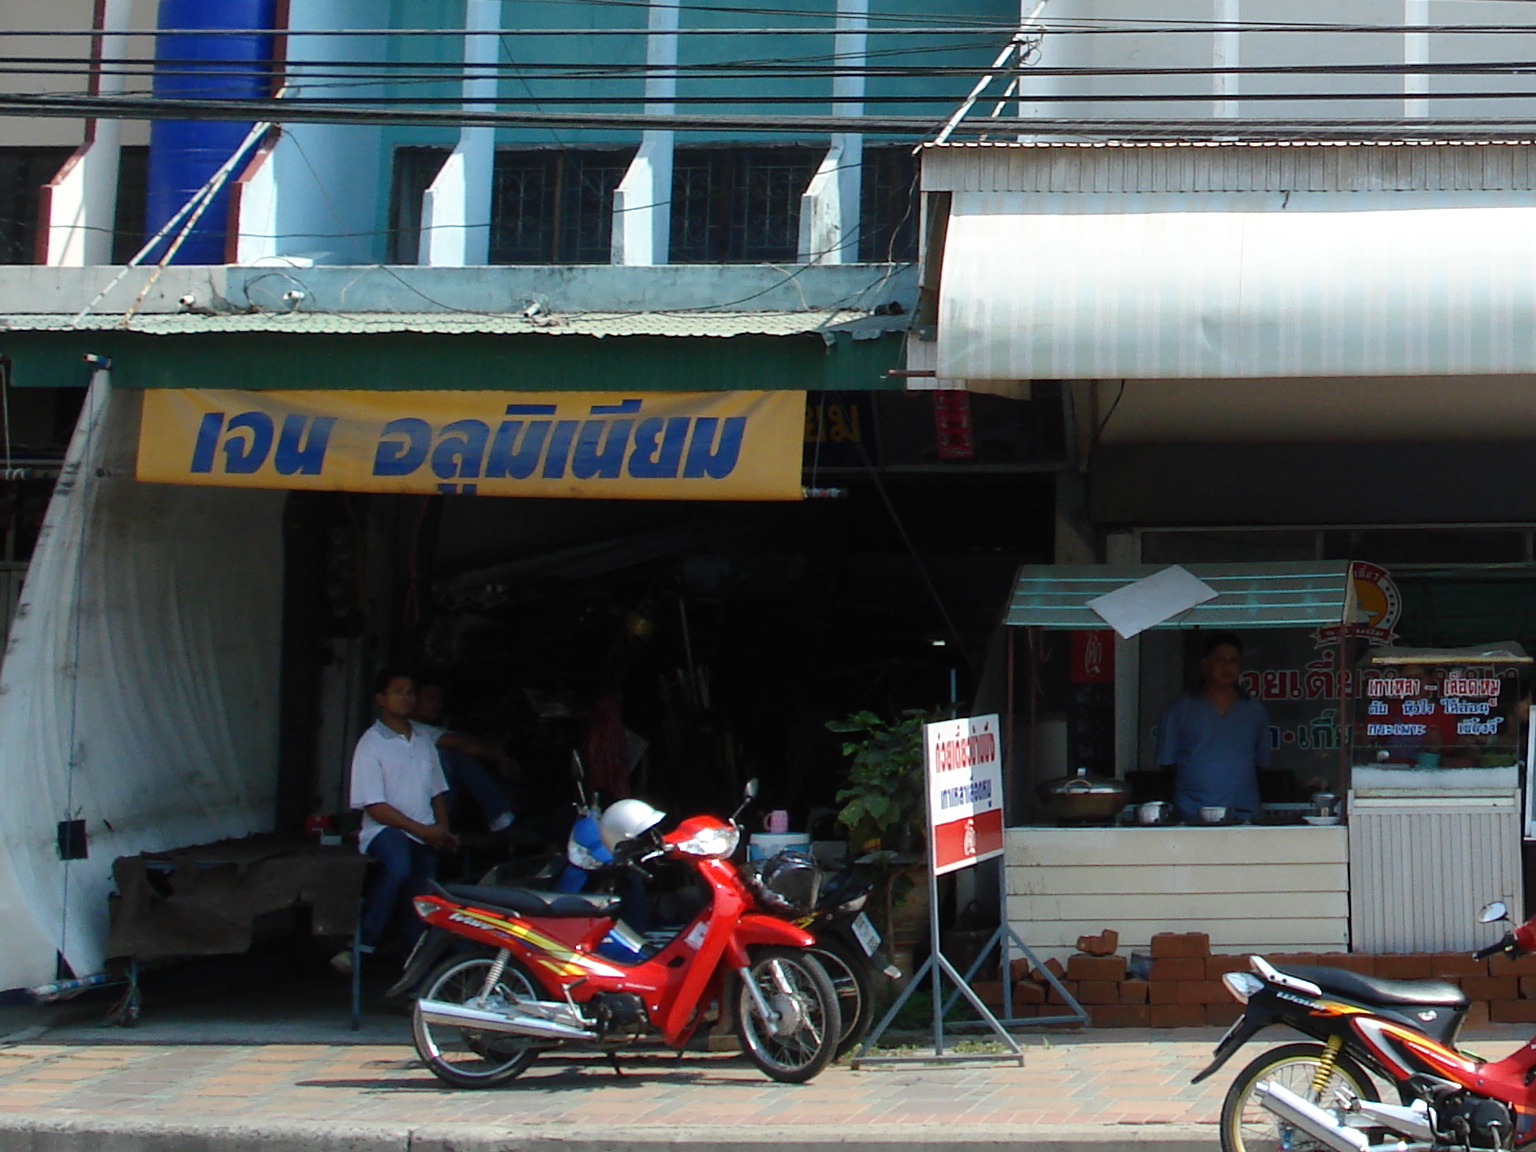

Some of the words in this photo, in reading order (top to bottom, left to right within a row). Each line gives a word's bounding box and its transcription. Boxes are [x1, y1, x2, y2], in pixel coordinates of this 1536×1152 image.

[190, 411, 336, 476] เจน
[371, 399, 748, 496] อลูมิเนียม
